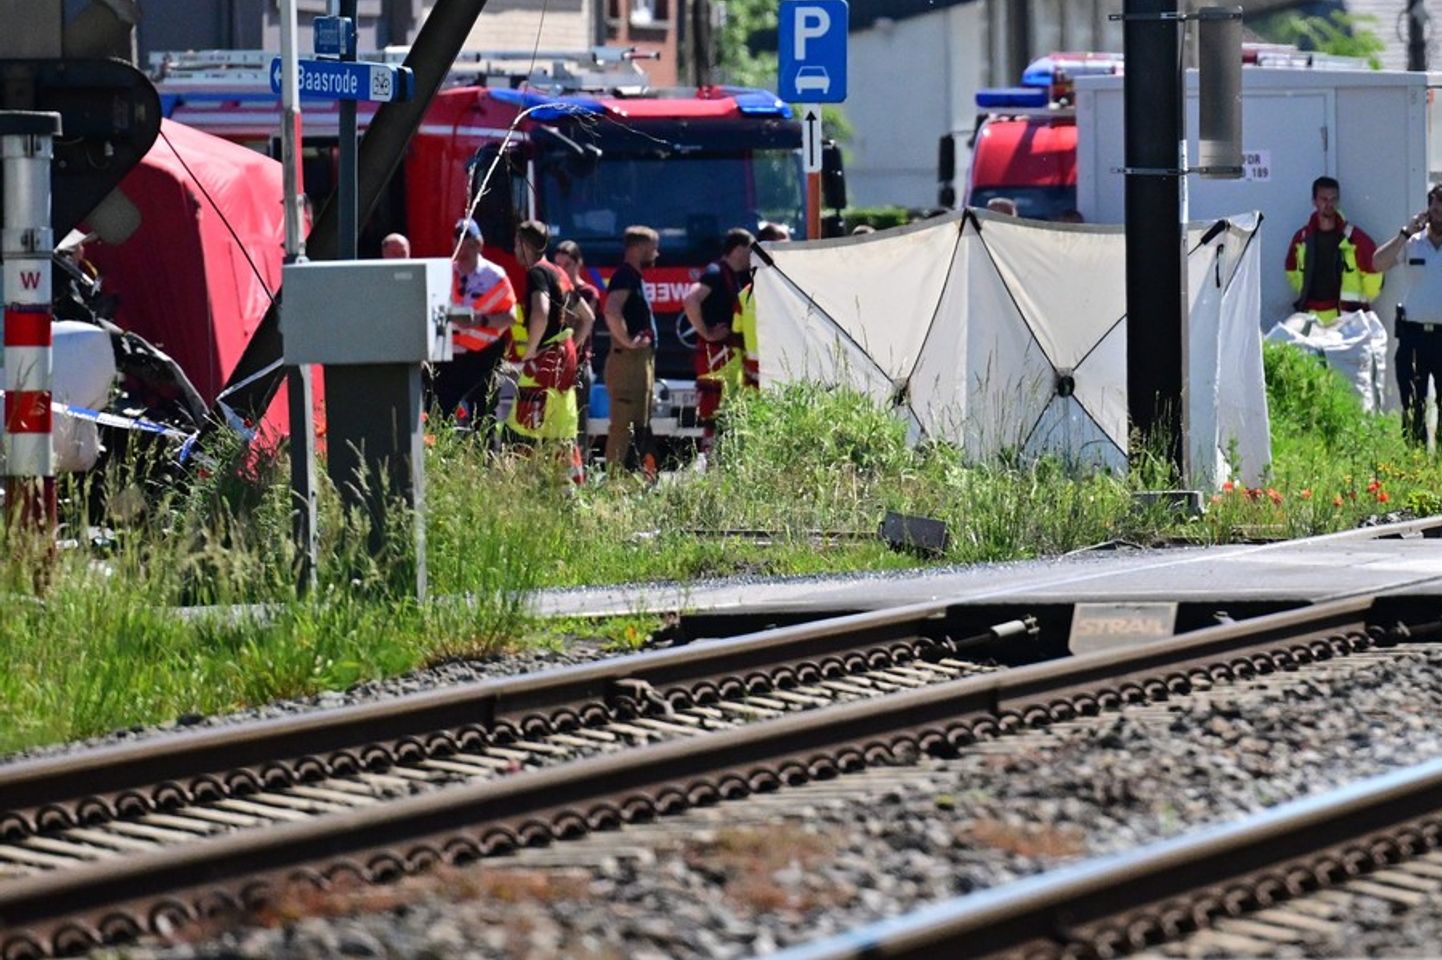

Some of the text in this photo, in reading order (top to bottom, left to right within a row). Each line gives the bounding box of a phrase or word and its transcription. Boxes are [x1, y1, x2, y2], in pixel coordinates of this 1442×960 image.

[795, 6, 830, 60] P
[299, 65, 358, 94] Baasrode
[20, 271, 41, 290] W
[1077, 618, 1167, 636] STRAIL
